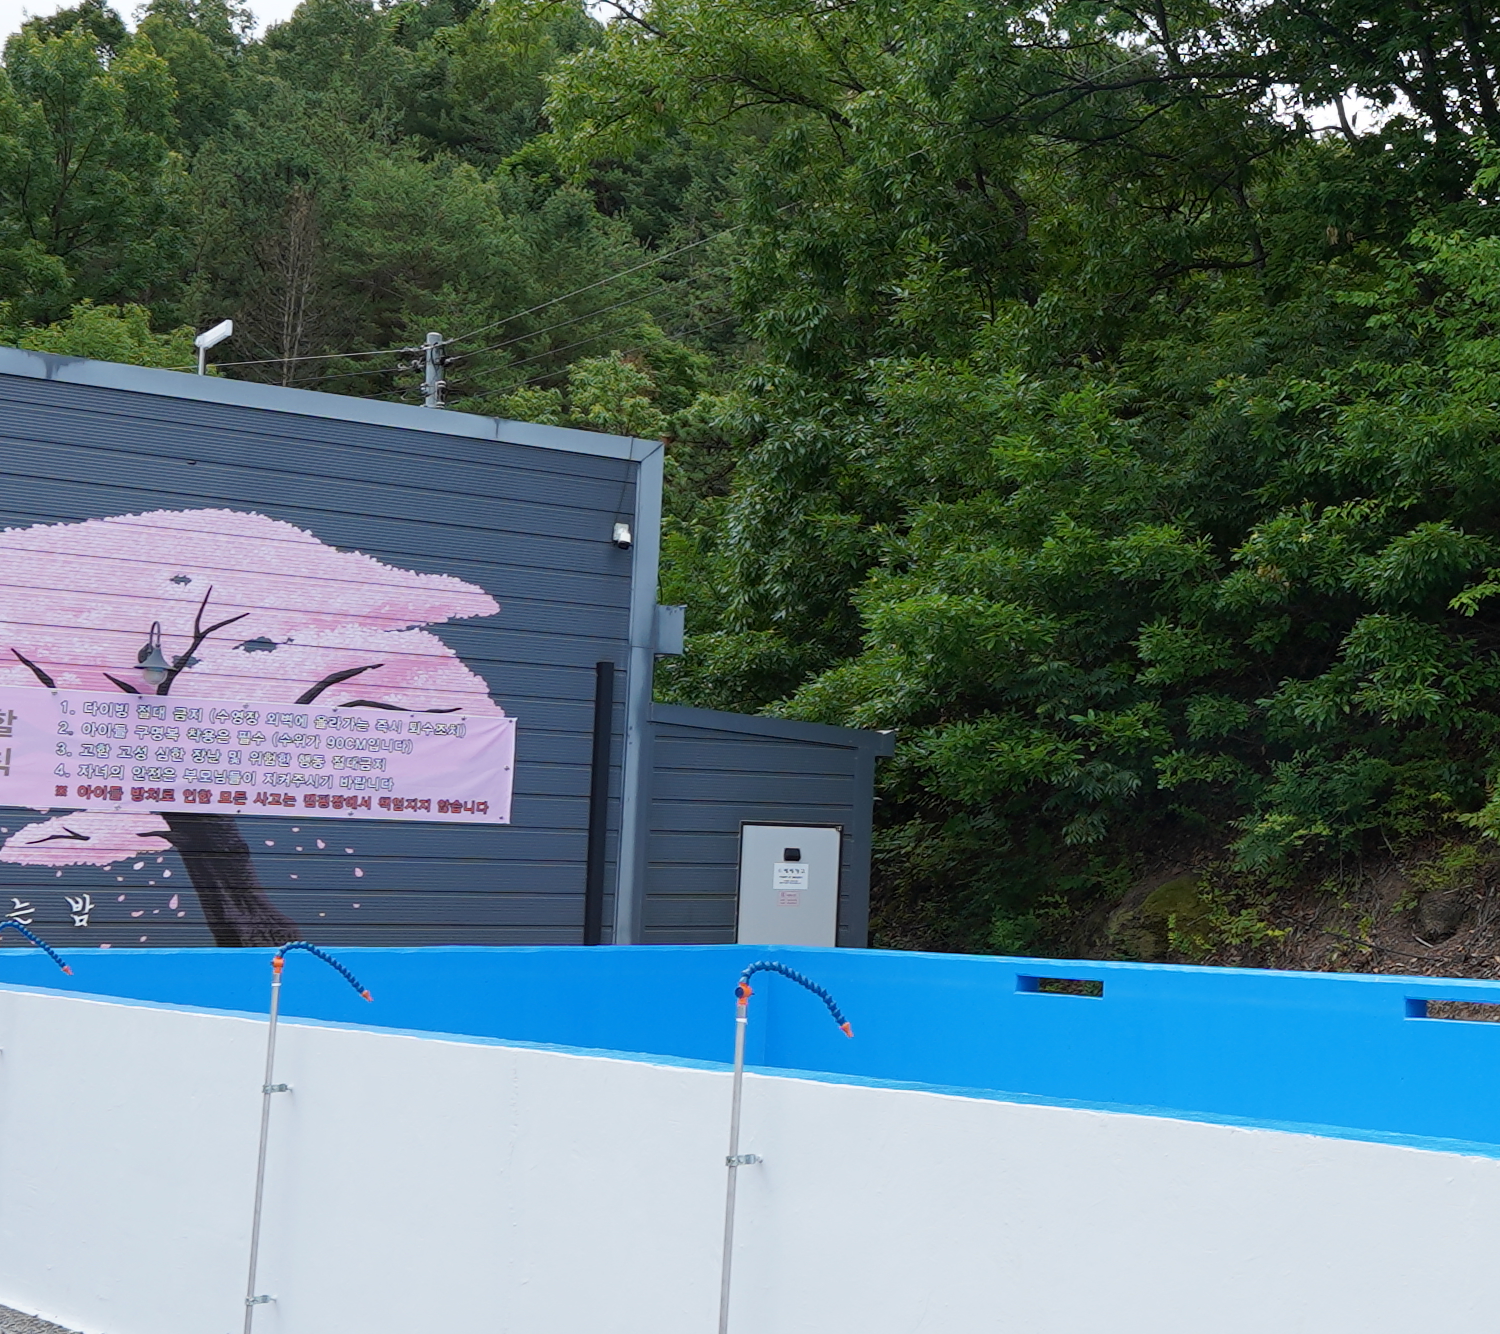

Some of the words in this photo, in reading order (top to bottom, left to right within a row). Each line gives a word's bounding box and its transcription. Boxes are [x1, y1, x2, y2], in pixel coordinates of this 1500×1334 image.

[60, 700, 75, 715] 1.
[83, 701, 129, 718] 다이빙
[136, 704, 166, 720] 절대
[173, 707, 203, 723] 금지
[209, 708, 260, 726] (수영장
[265, 711, 308, 729] 외벽에
[314, 715, 370, 732] 올라가는
[375, 718, 402, 734] 즉시
[408, 721, 467, 739] 퇴수조치)
[57, 721, 74, 736] 2.
[81, 722, 128, 739] 아이들
[134, 725, 180, 742] 구명복
[186, 727, 231, 744] 착용은
[237, 730, 266, 746] 필수
[272, 731, 321, 749] (수위가
[326, 736, 413, 755] 90CM입니다)
[55, 742, 72, 757] 3.
[79, 742, 112, 759] 고함
[117, 746, 148, 761] 고성
[155, 747, 186, 763] 심한
[191, 748, 222, 764] 장난
[228, 750, 242, 765] 및
[248, 750, 292, 767] 위험한
[298, 753, 326, 769] 행동
[332, 755, 386, 772] 절대금지
[54, 763, 71, 778] 4.
[77, 763, 125, 780] 자녀의
[132, 765, 177, 782] 안전은
[182, 768, 257, 786] 부모님들이
[263, 771, 334, 789] 지켜주시기
[340, 775, 395, 792] 바랍니다
[77, 784, 124, 801] 아이들
[131, 787, 176, 802] 방치로
[183, 788, 213, 804] 인한
[217, 790, 248, 806] 모든
[253, 791, 297, 807] 사고는
[303, 793, 372, 810] 캠핑장에서
[378, 796, 431, 813] 책임지지
[437, 799, 490, 815] 않습니다
